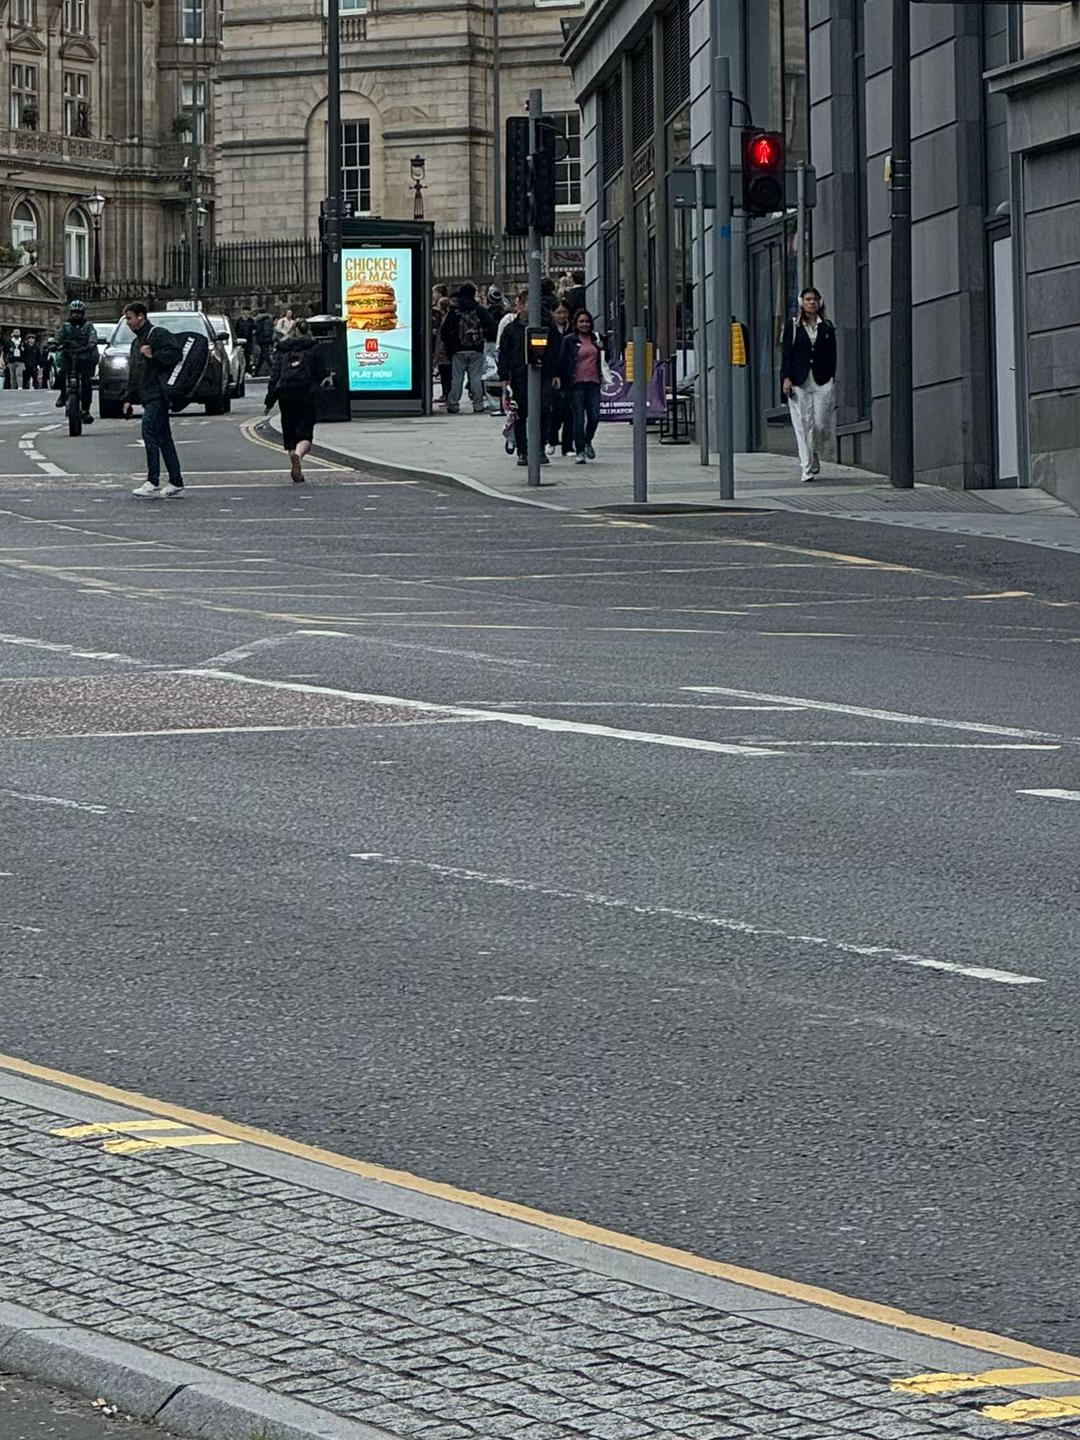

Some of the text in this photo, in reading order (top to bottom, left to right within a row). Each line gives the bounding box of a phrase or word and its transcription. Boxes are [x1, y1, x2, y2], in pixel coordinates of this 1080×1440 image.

[345, 257, 397, 271] CHICKEN
[345, 271, 397, 282] BIG MAC
